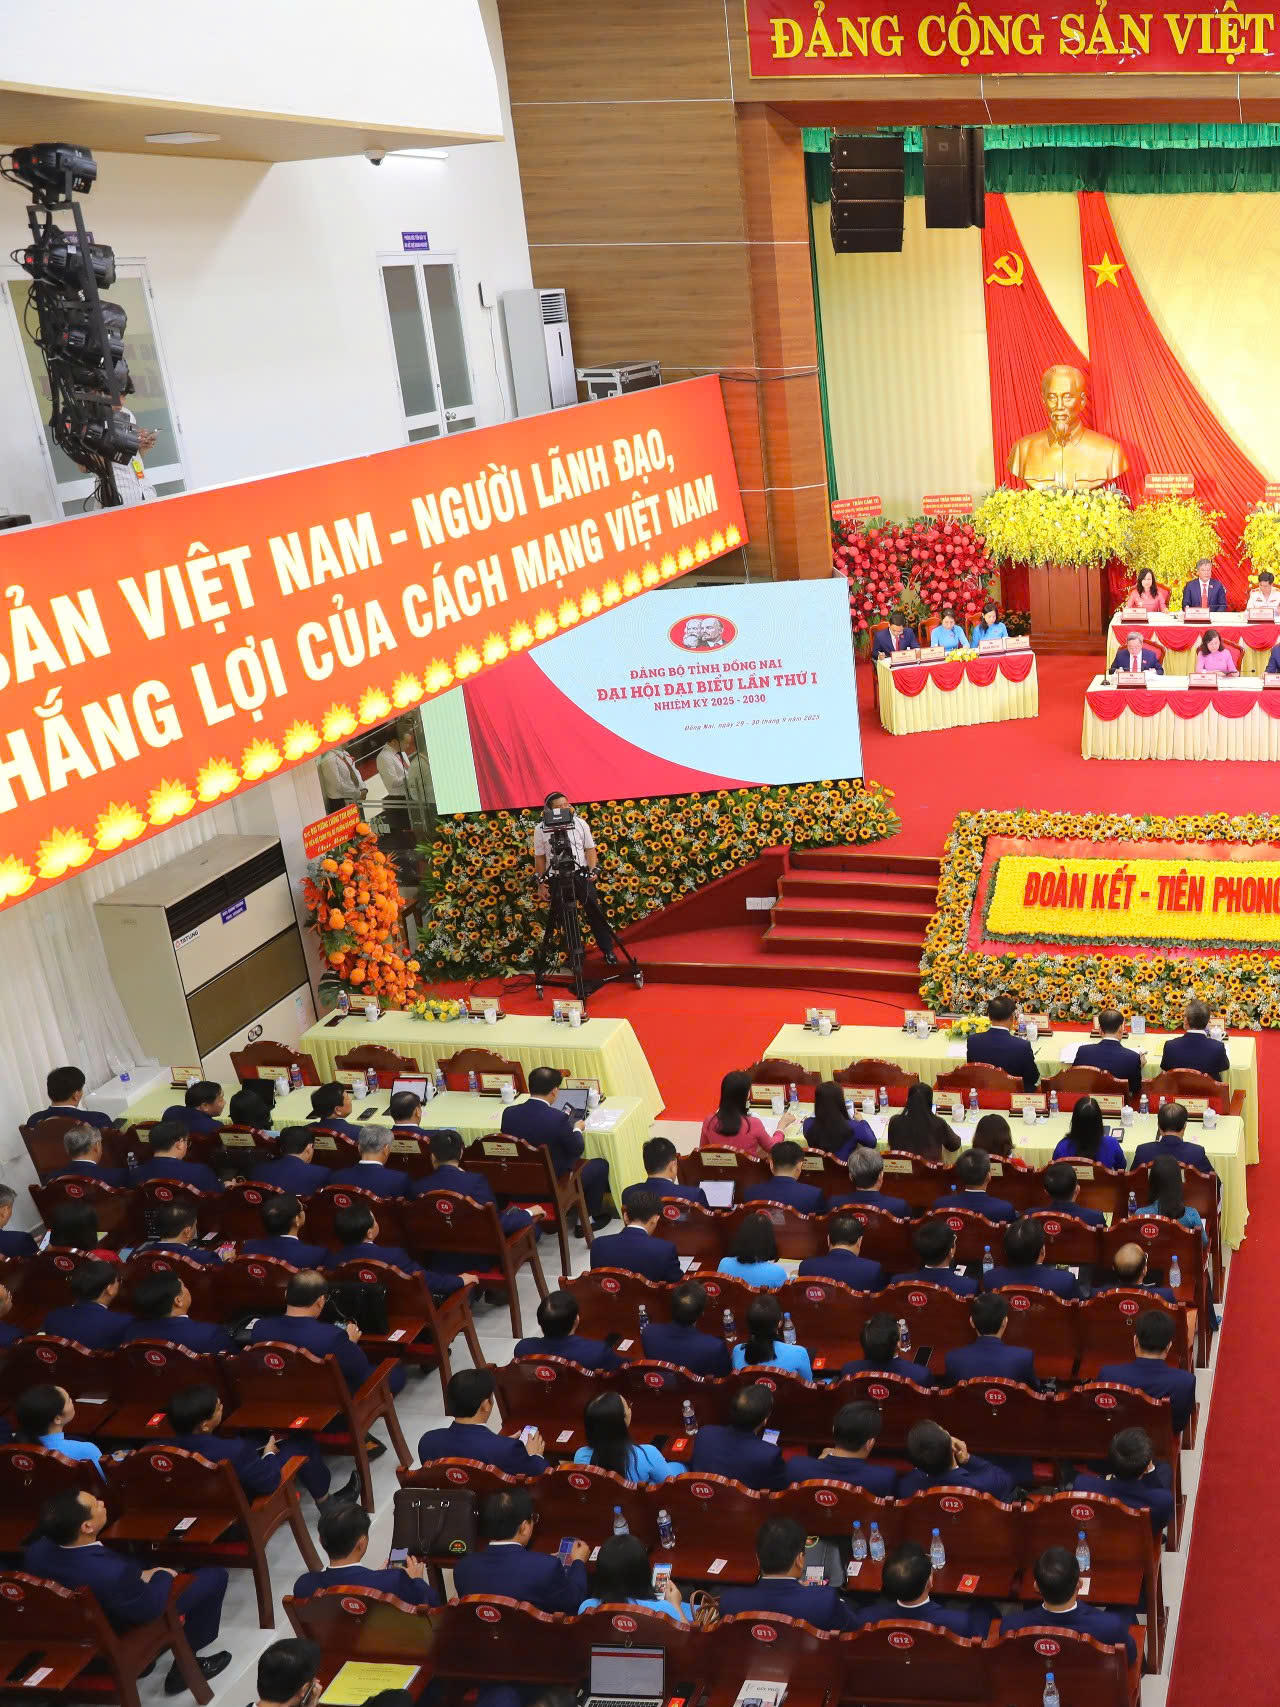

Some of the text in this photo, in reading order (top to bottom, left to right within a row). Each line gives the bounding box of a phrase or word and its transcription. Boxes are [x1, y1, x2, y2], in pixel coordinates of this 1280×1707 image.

[770, 1, 904, 58] ĐẢNG
[918, 3, 1044, 66] CỘNG
[1060, 0, 1153, 54] SẢN
[1164, 0, 1274, 64] VIỆT
[0, 427, 676, 692] ẢN VIỆT NAM NGƯỜI LÃNH ĐẠO,
[191, 628, 283, 726] LỢI
[295, 591, 398, 682] CỦA
[401, 560, 507, 638] CÁCH
[513, 517, 603, 591] MẠNG
[605, 490, 662, 551] VIỆT
[669, 474, 719, 528] NAM
[597, 670, 818, 702] ĐẠI HỘI ĐẠI BIỂU LẦN THỨ I
[630, 658, 783, 680] ĐẢNG BỘ TỈNH ĐỒNG NAI
[654, 694, 766, 711] NHIỆM KỲ 2025 2030
[1024, 867, 1086, 908] ĐOÀN
[1092, 865, 1136, 909] KẾT
[1158, 871, 1204, 912] TIÊN
